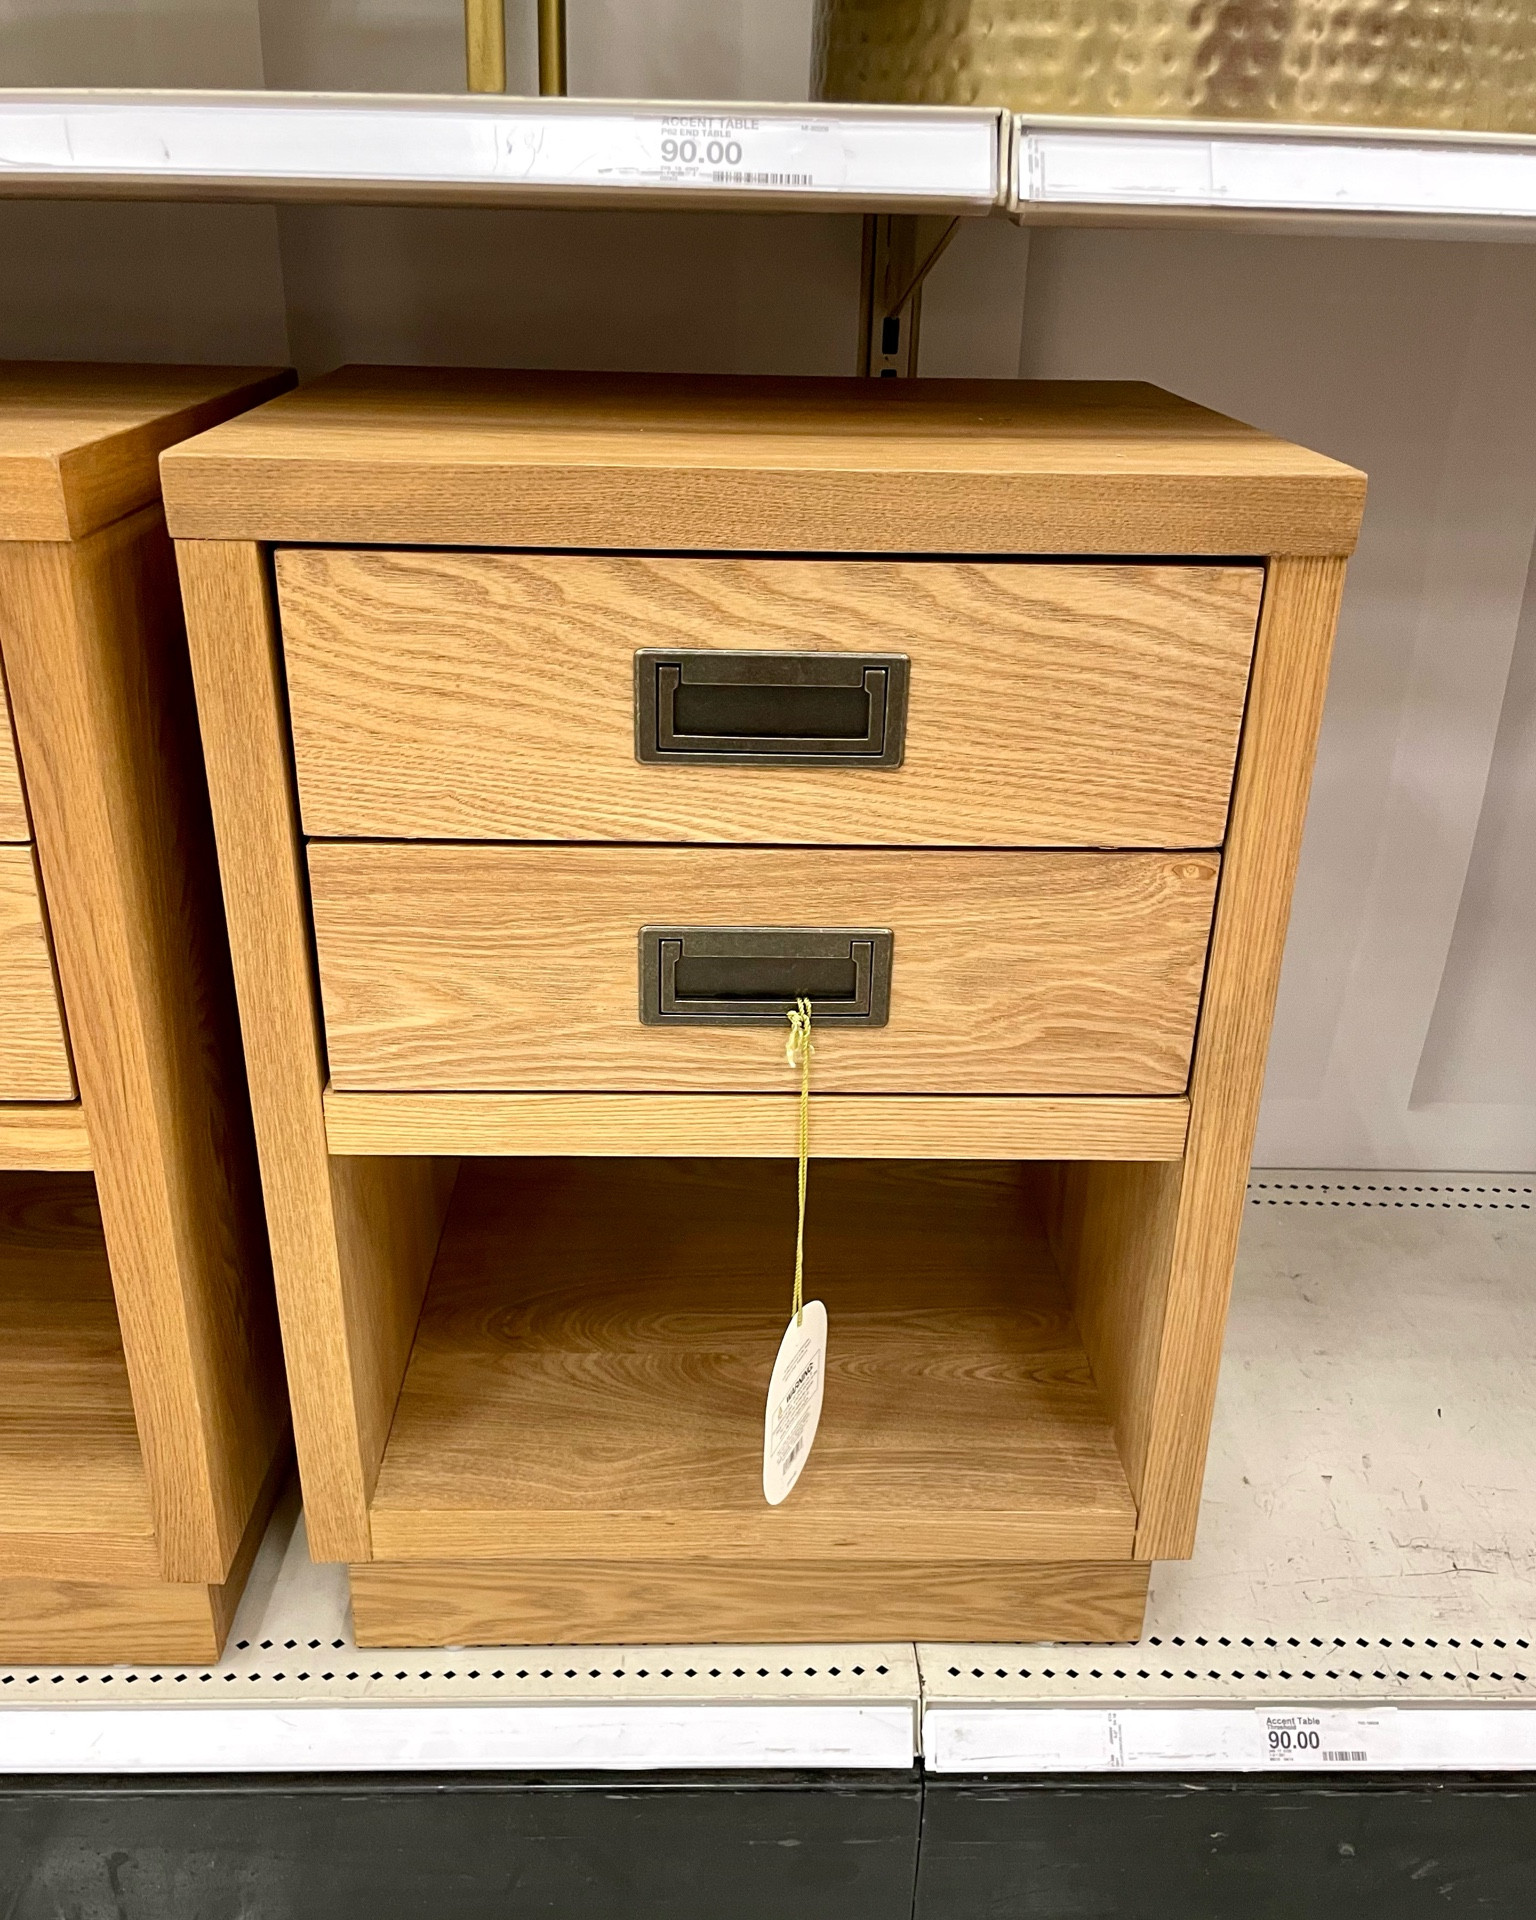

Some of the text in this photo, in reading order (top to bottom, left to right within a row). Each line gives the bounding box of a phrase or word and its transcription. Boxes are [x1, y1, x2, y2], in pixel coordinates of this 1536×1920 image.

[661, 117, 759, 130] ACCENT TABLE
[680, 128, 700, 137] END
[701, 129, 731, 138] TABLE
[661, 139, 742, 165] 90.00
[786, 1362, 813, 1403] WARNING
[1266, 1717, 1320, 1725] Accent Table
[1268, 1731, 1320, 1749] 90.00
